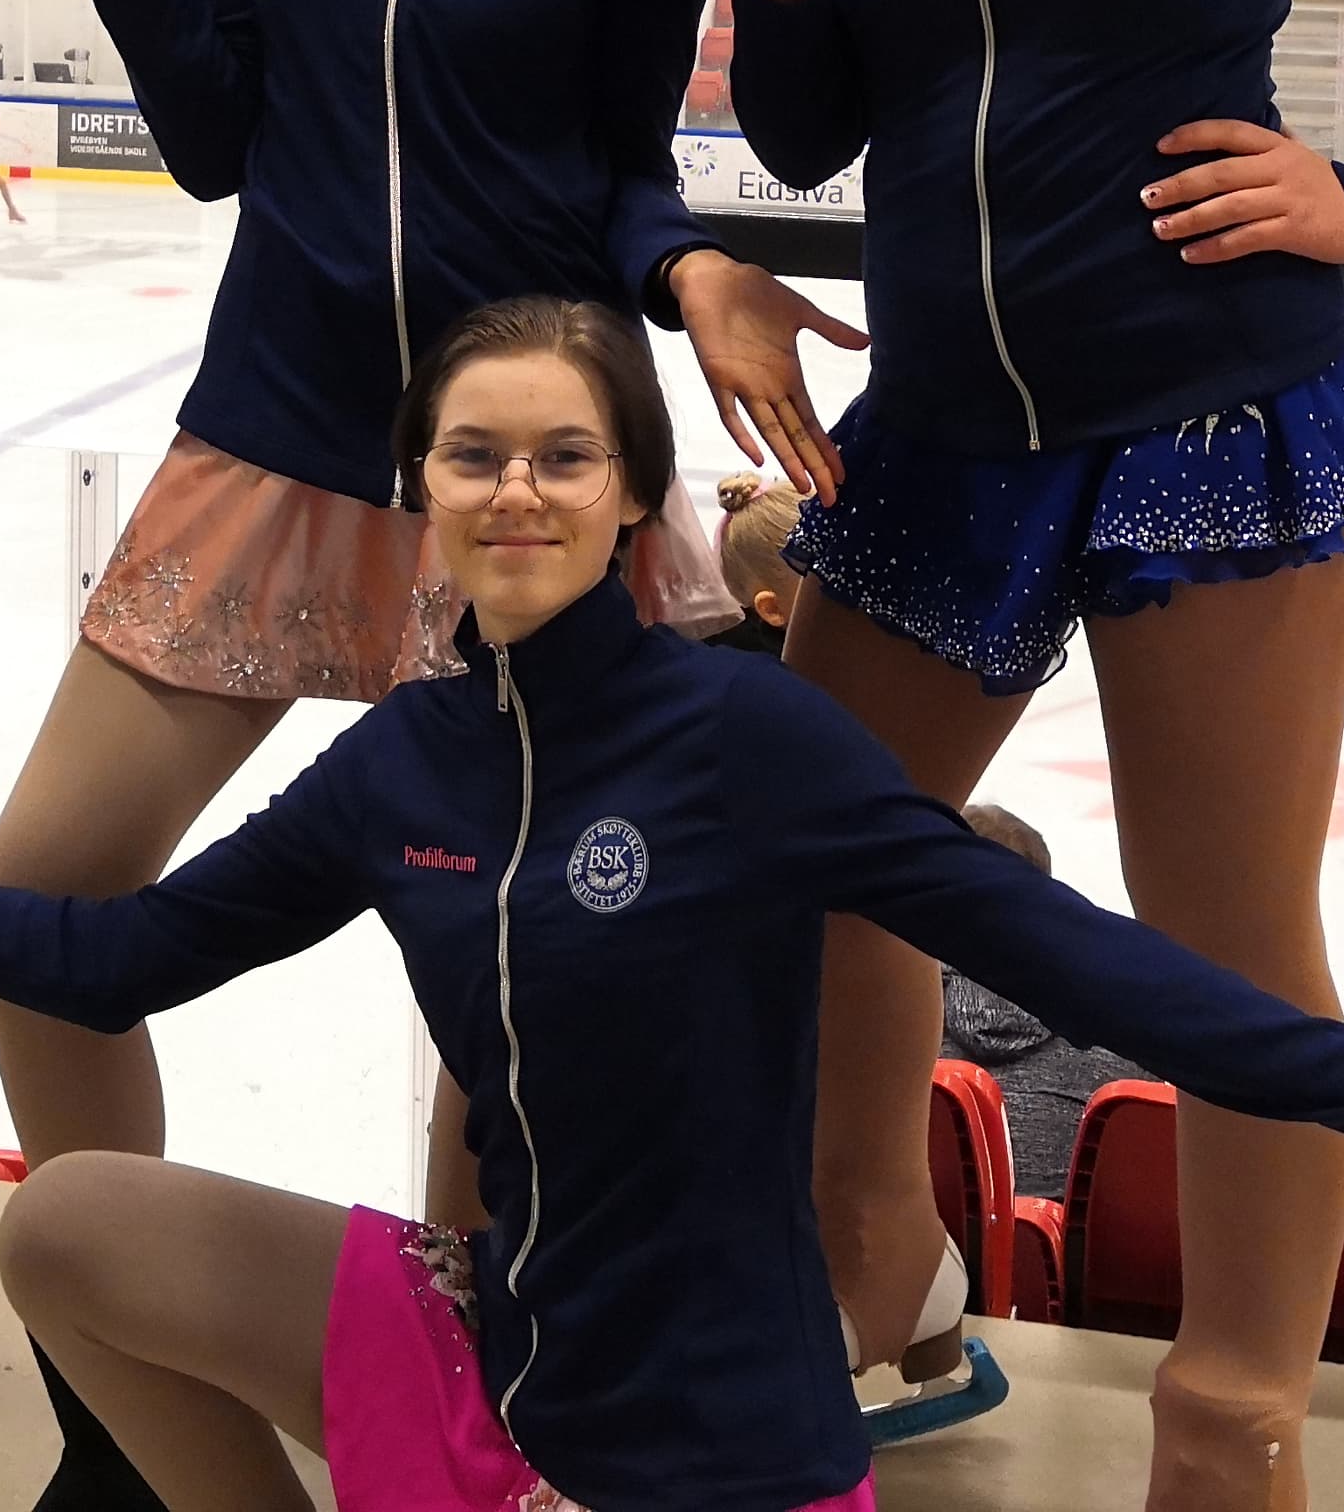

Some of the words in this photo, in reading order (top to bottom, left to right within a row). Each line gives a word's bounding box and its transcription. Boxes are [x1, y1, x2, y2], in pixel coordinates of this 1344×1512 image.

[404, 845, 477, 872] Profilforum
[587, 845, 629, 869] BSK
[576, 879, 614, 906] STIFTET
[616, 881, 636, 903] 1975
